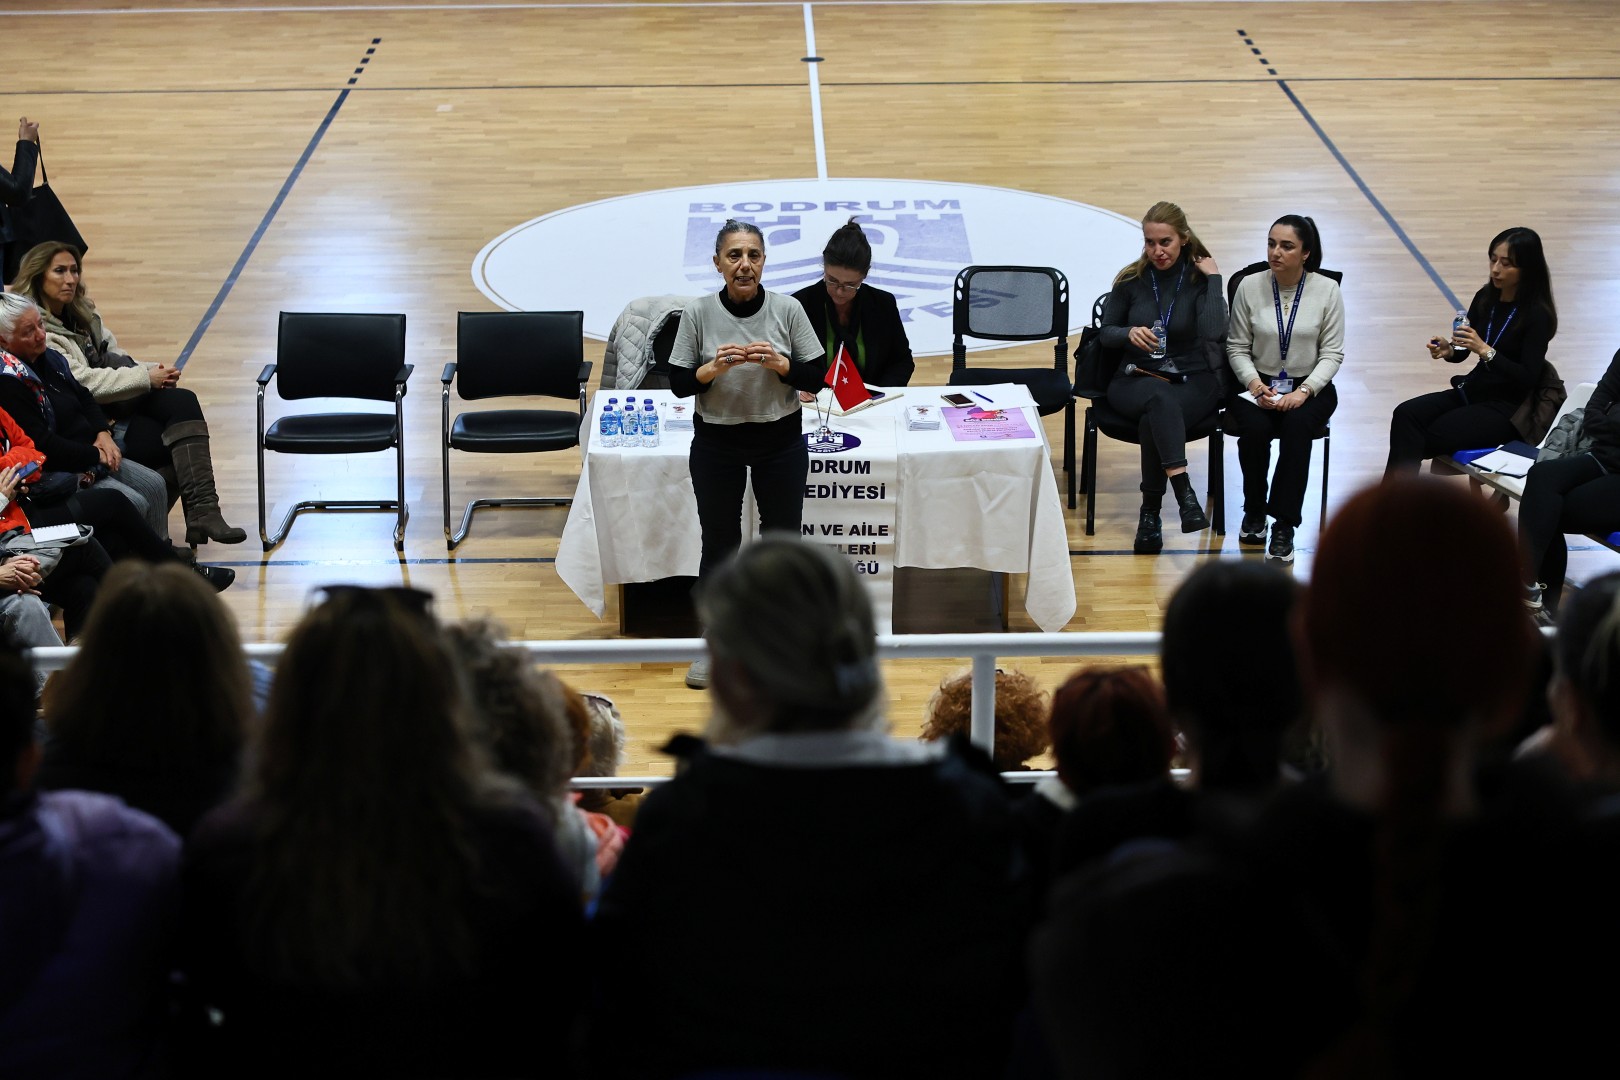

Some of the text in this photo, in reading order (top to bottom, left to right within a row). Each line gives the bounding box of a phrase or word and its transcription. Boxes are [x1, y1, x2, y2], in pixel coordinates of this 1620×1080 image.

[688, 200, 961, 213] BODRUM
[810, 460, 871, 474] DRUM
[804, 482, 886, 499] EDİYESİ
[802, 522, 889, 536] N VE AİLE
[837, 542, 877, 555] LERİ
